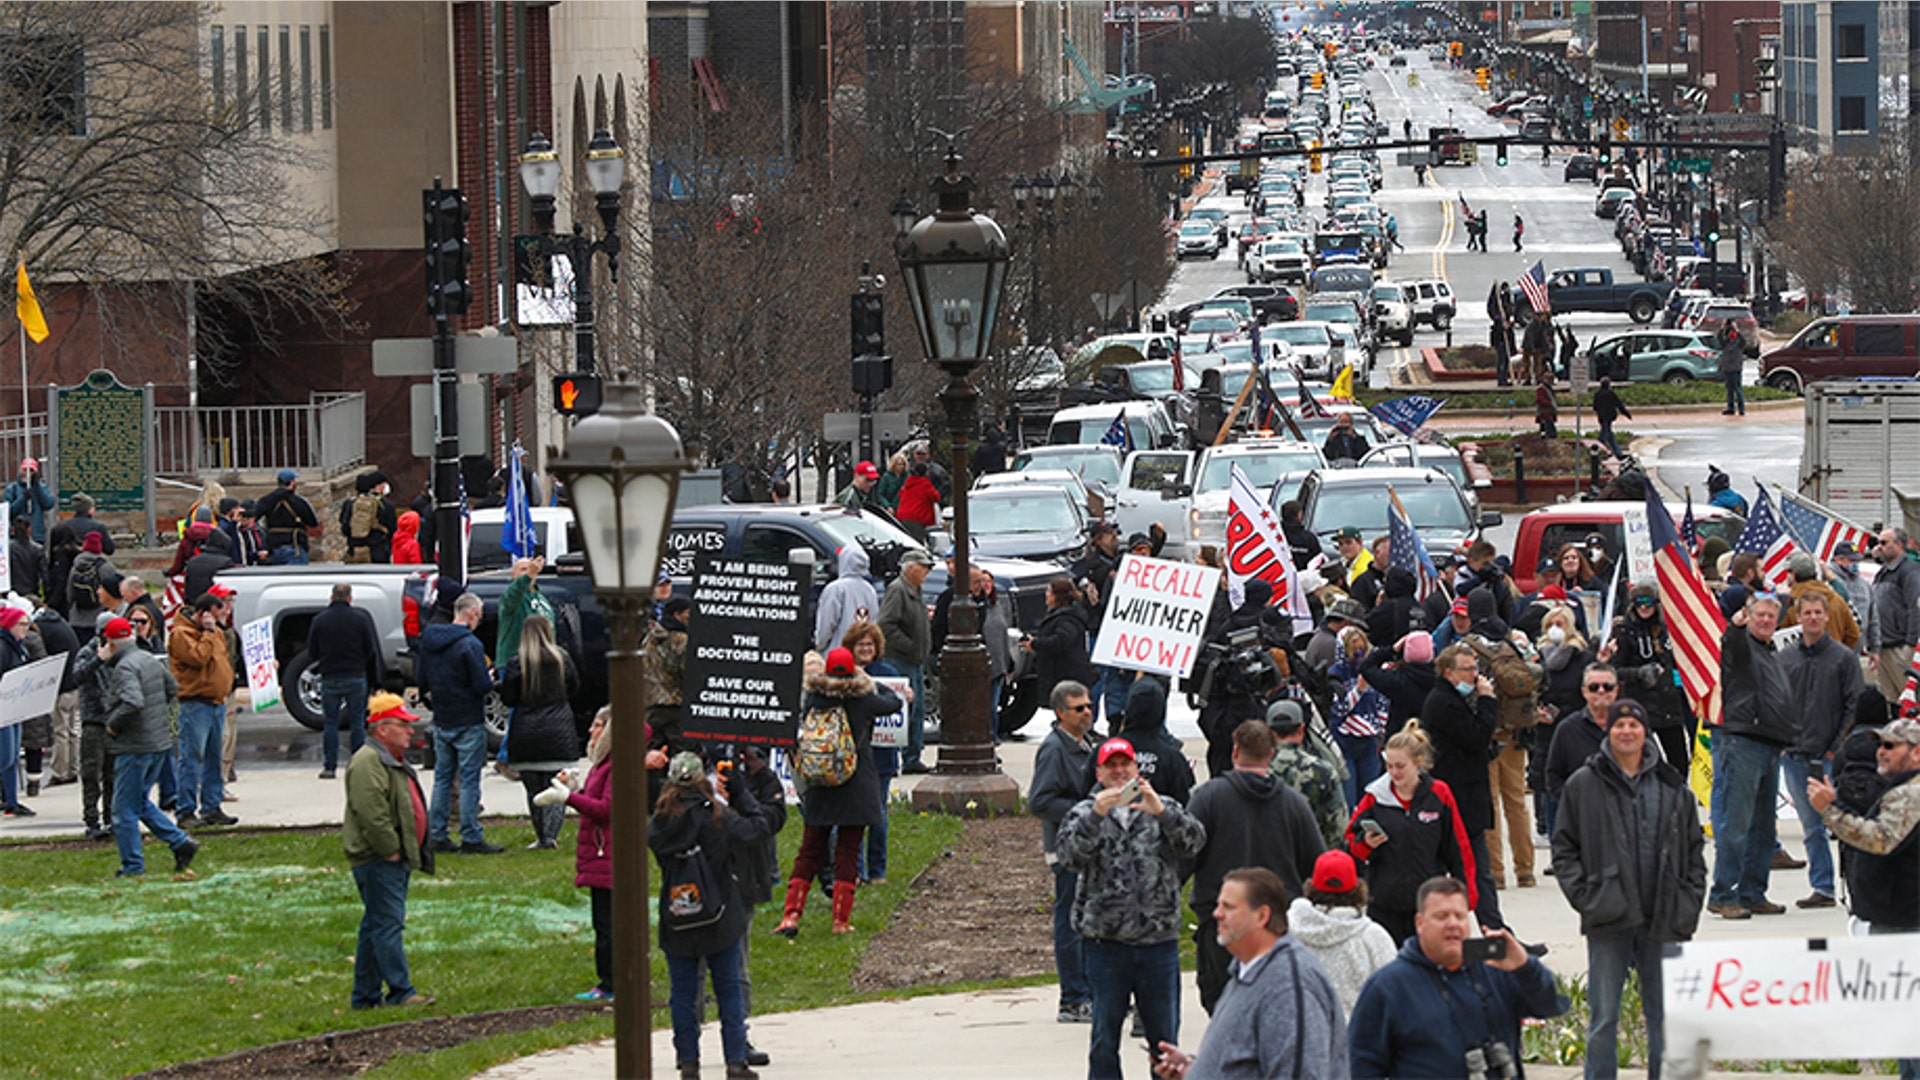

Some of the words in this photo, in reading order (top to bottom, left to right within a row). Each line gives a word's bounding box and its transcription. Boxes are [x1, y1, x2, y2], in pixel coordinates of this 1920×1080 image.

[724, 561, 744, 574] AM
[747, 563, 789, 577] BEING
[700, 574, 753, 588] PROVEN
[756, 578, 798, 592] RIGHT
[1123, 558, 1204, 599] RECALL
[694, 588, 740, 602] ABOUT
[742, 592, 801, 607] MASSIVE
[698, 602, 798, 621] VACCINATIONS
[1112, 595, 1204, 636] WHITMER
[732, 634, 760, 647] THE
[697, 646, 760, 662] DOCTORS
[762, 651, 793, 665] LIED
[1114, 633, 1192, 675] NOW!
[707, 676, 742, 690] SAVE
[745, 679, 775, 692] OUR
[699, 690, 766, 706] CHILDREN
[769, 695, 779, 707] &
[690, 704, 730, 718] THEIR
[733, 707, 792, 722] FUTURE"
